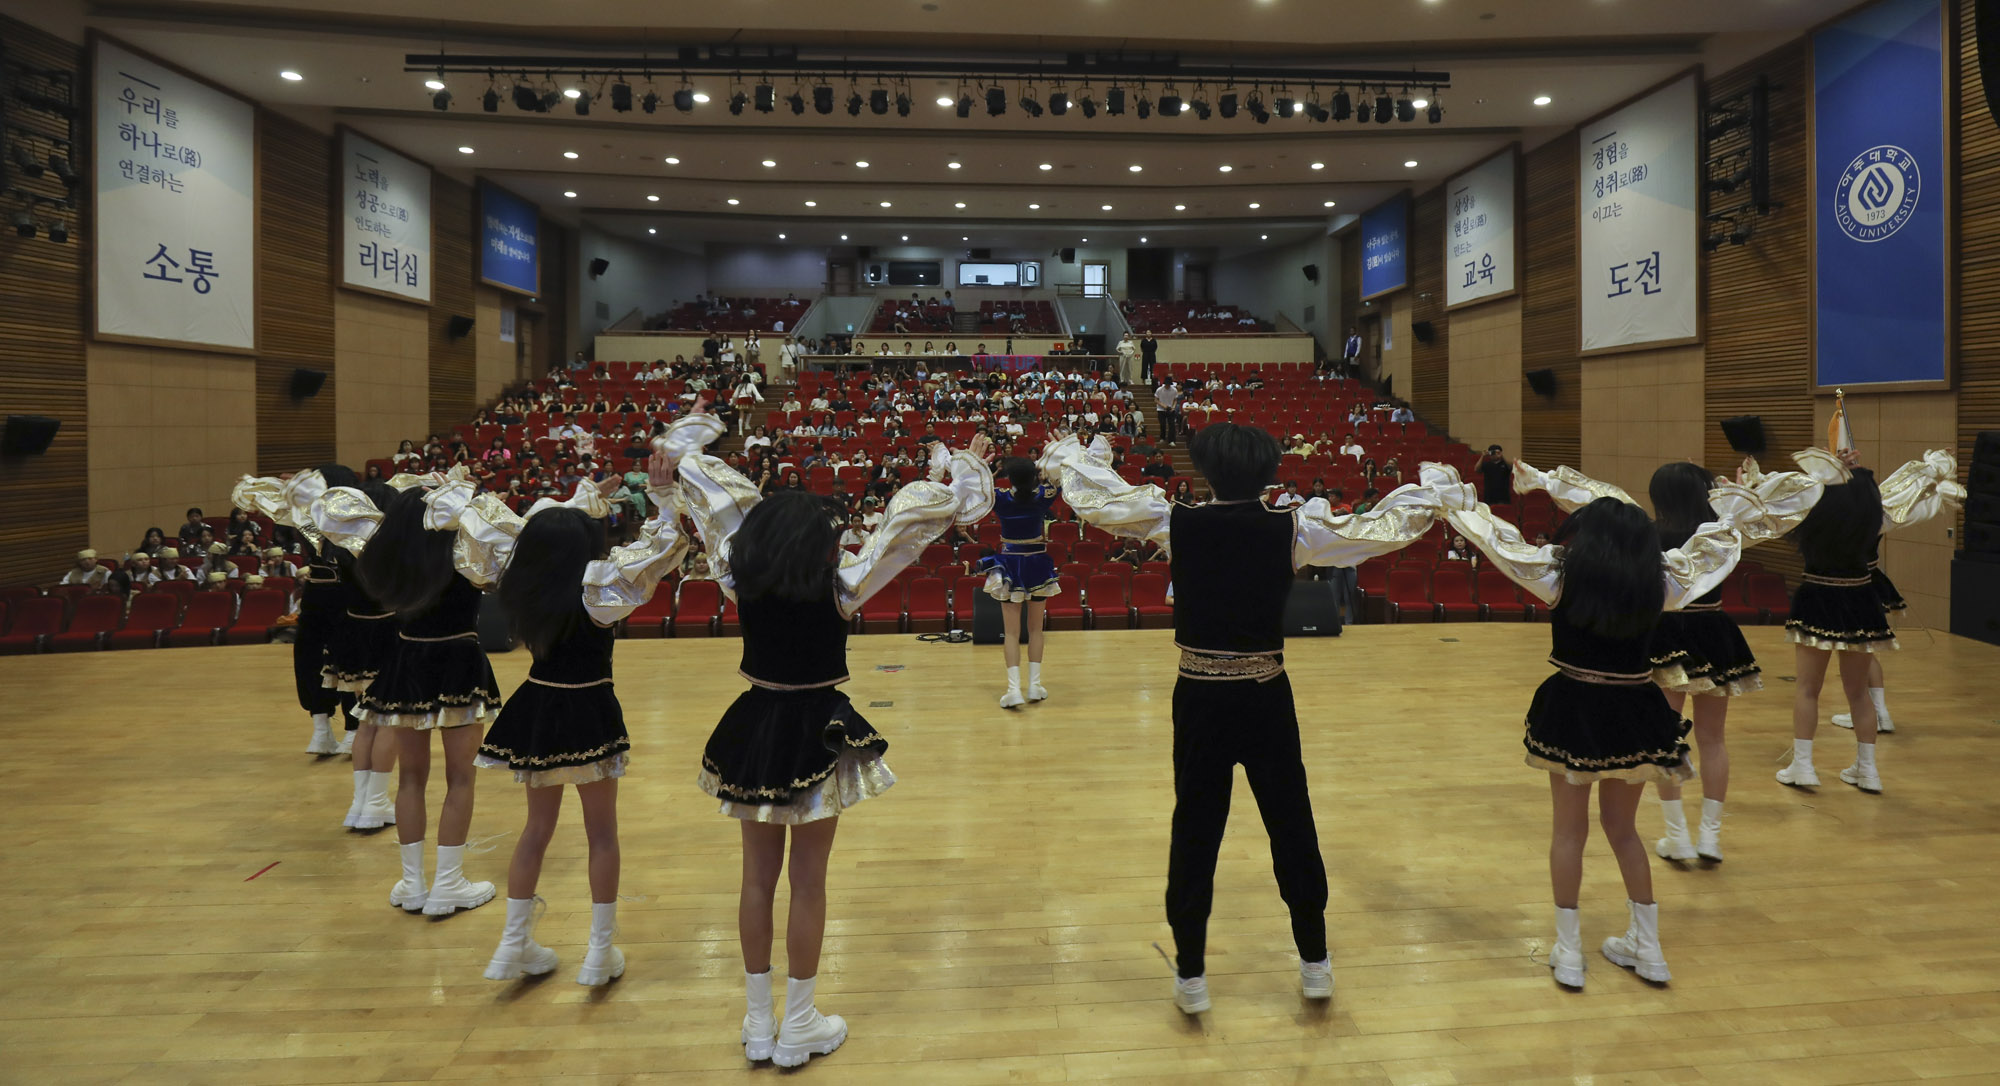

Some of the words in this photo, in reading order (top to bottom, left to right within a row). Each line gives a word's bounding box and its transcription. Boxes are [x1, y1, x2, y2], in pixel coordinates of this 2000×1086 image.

[118, 87, 179, 129] 우리를
[118, 123, 201, 168] 하나로(路)
[1592, 142, 1629, 170] 경험을
[119, 159, 184, 194] 연결하는
[355, 164, 389, 191] 노력을
[1592, 163, 1647, 198] 성취로(路)
[1842, 149, 1911, 187] 아주대학교
[1454, 195, 1475, 216] 상상을
[1592, 202, 1623, 222] 이끄는
[1838, 204, 1857, 232] AJOU
[1859, 187, 1916, 238] UNIVERSITY
[1866, 209, 1886, 222] 1973
[355, 216, 391, 239] 인도하는
[359, 241, 418, 288] 리더십
[1454, 241, 1472, 257] 만드는
[143, 243, 219, 295] 소통
[1462, 253, 1496, 288] 교육
[1607, 251, 1662, 298] 도전
